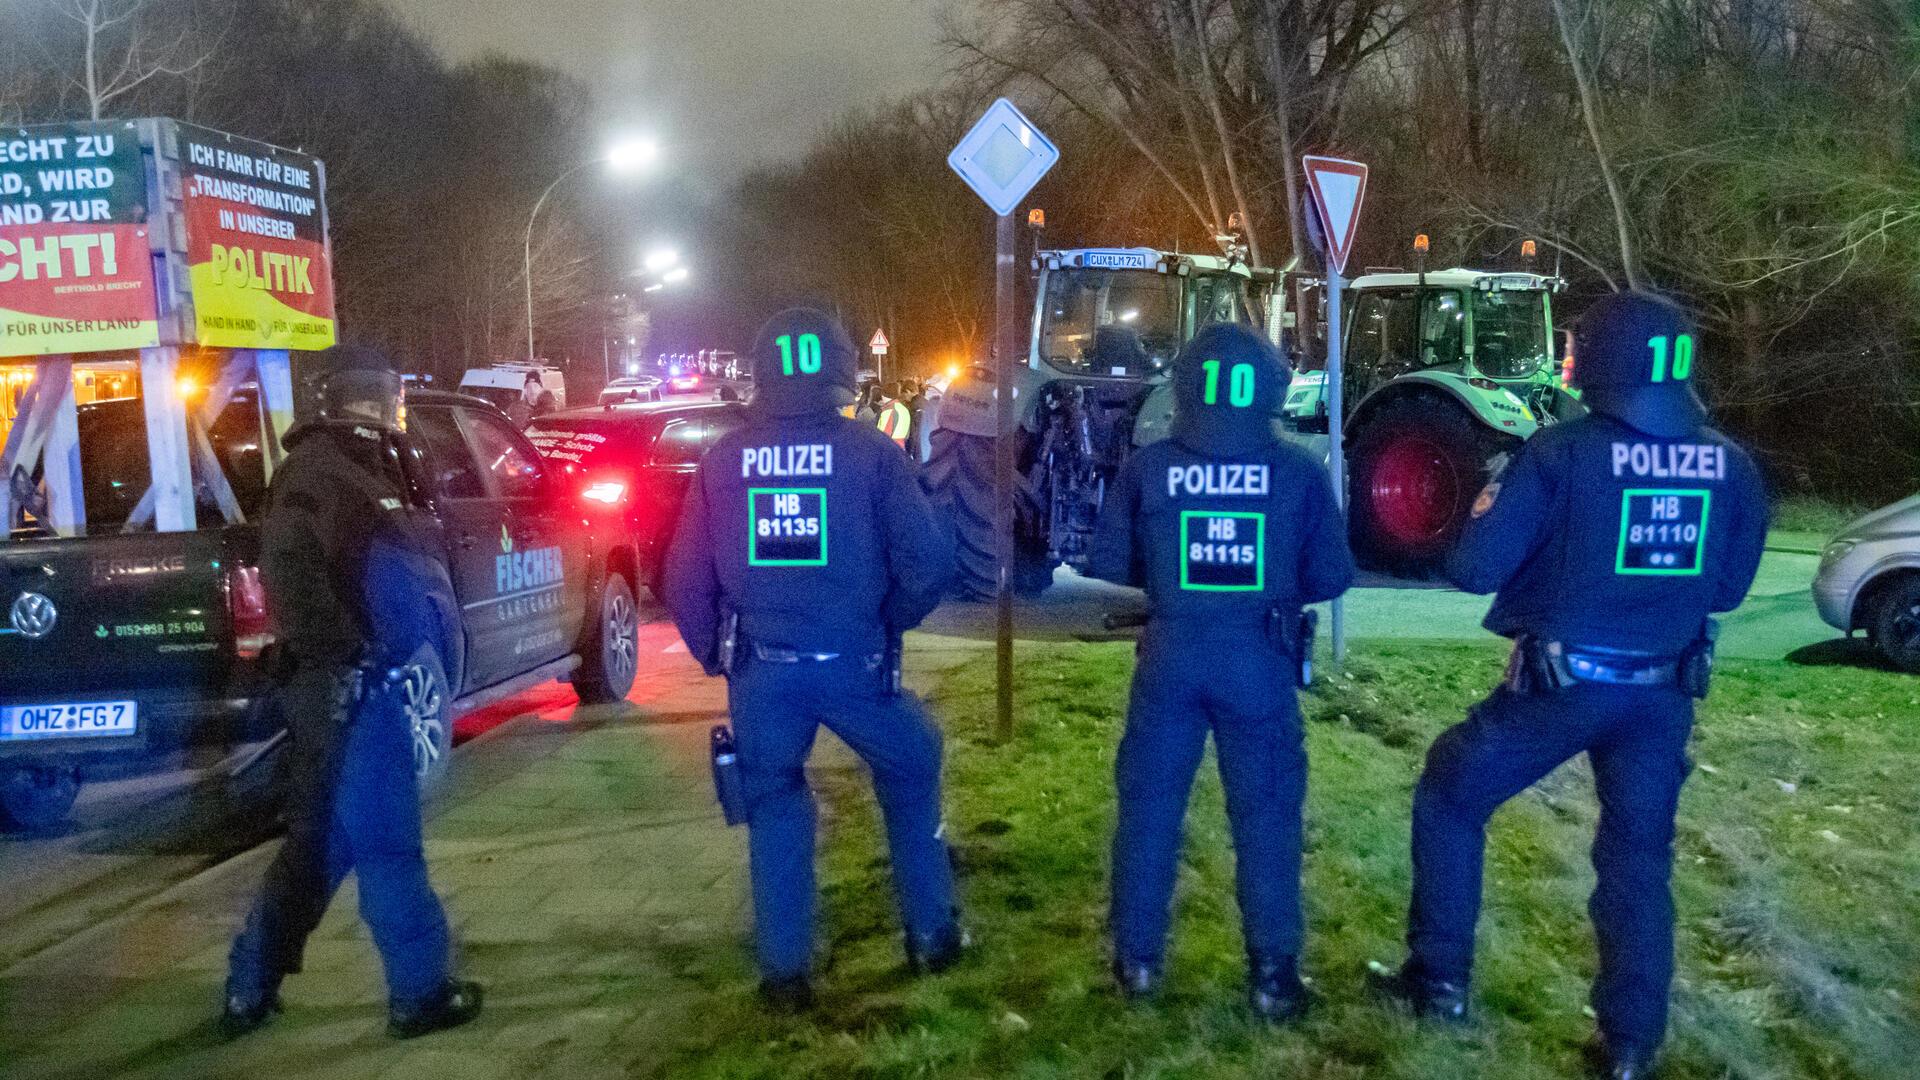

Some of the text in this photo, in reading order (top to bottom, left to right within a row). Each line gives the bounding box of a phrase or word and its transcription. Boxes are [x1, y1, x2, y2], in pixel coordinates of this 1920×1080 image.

[75, 135, 114, 158] ZU
[189, 142, 311, 190] ICH FAHR FÜR EINE
[0, 167, 114, 198] D, WIRD
[52, 199, 112, 223] ZUR
[219, 209, 296, 241] IN UNSERER
[211, 243, 314, 295] POLITIK
[54, 281, 142, 295] BERTHOLD BRECHT
[7, 316, 141, 336] FÜR UNSER LAND
[202, 316, 224, 329] HAND
[225, 318, 234, 330] IN
[235, 319, 256, 332] HAND
[273, 320, 289, 333] FÜR
[310, 323, 328, 336] LAND
[775, 333, 822, 376] 10
[1647, 334, 1693, 382] 10
[1202, 360, 1255, 407] 10
[742, 444, 833, 478] POLIZEI
[1611, 442, 1726, 480] POLIZEI
[1167, 464, 1270, 497] POLIZEI
[774, 494, 801, 516] HB
[1651, 497, 1680, 520] HB
[757, 517, 819, 537] 81135
[1207, 517, 1237, 541] HB
[1629, 524, 1697, 543] 81110
[1189, 543, 1255, 564] 81115
[496, 546, 564, 593] FISCHER
[167, 622, 181, 634] 25
[20, 705, 126, 730] OHZ FG 7
